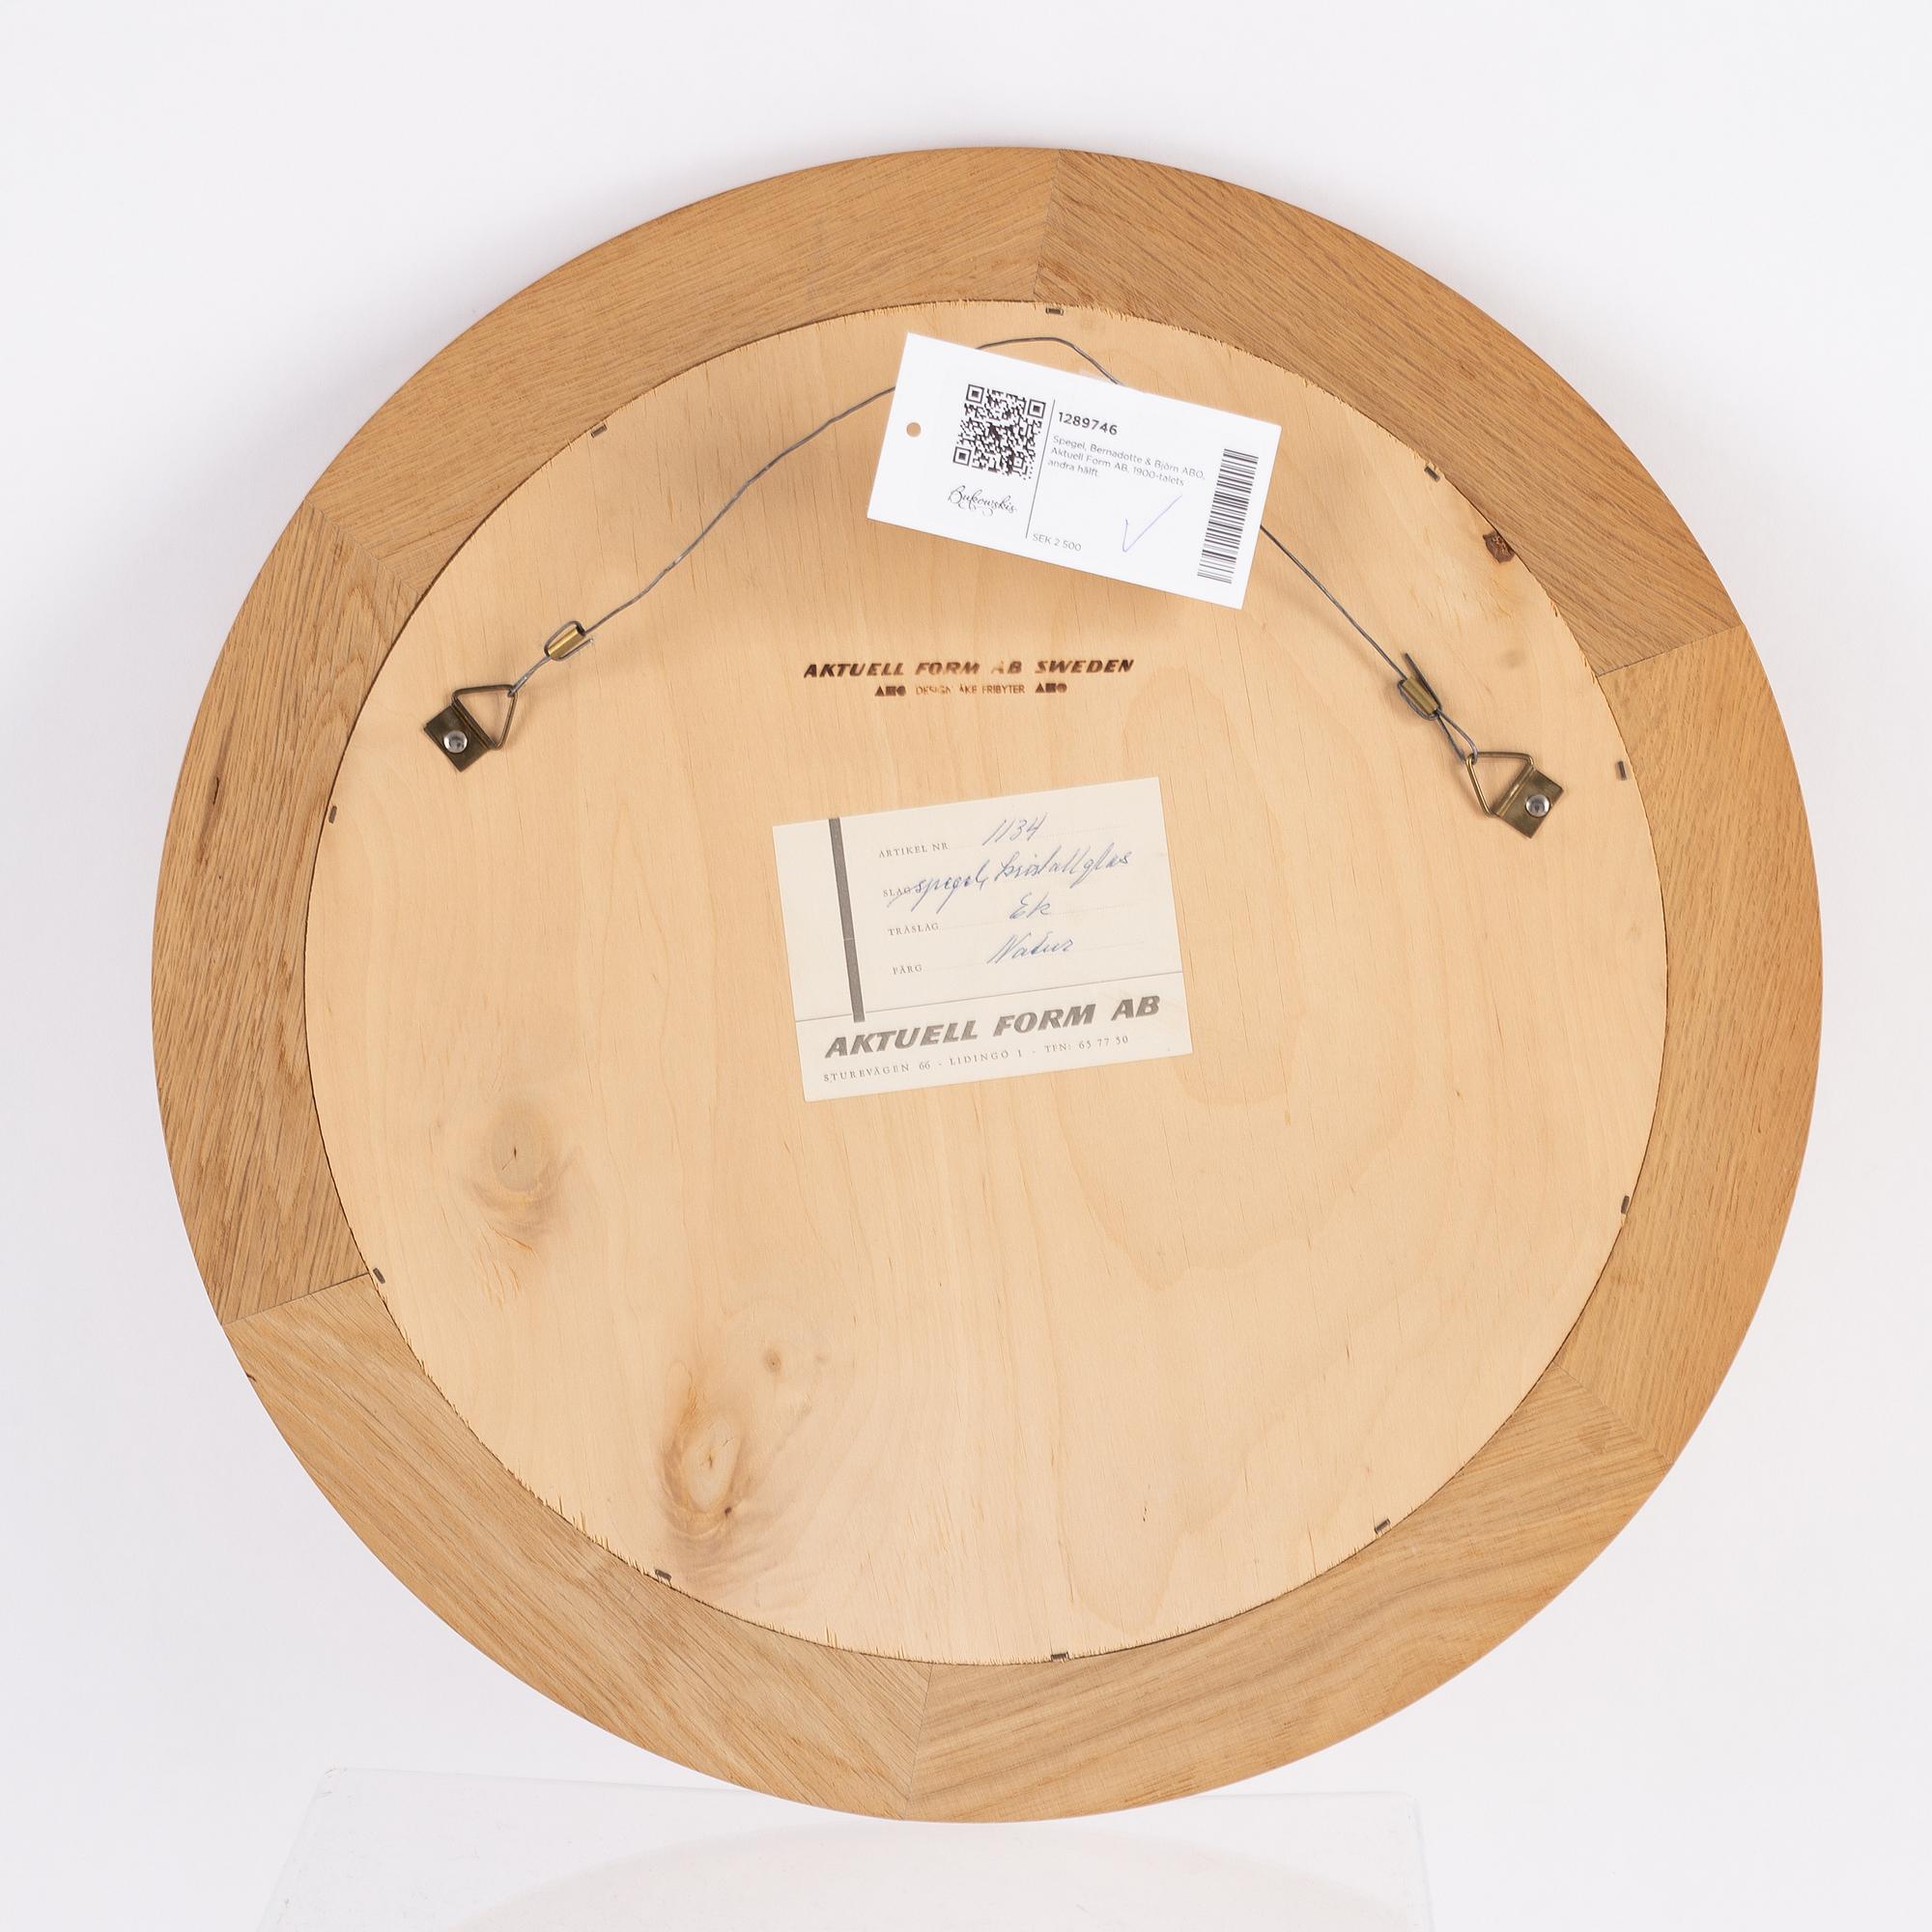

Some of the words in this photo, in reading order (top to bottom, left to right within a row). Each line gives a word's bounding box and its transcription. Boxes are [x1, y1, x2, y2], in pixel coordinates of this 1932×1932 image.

[1059, 412, 1118, 436] 1289746
[1053, 435, 1087, 451] Spegel,
[1090, 443, 1143, 465] Bernadotte
[1145, 457, 1151, 466] &
[1047, 459, 1075, 471] andra
[1051, 447, 1084, 462] Aktuell
[1086, 454, 1111, 468] Form
[1133, 467, 1184, 487] 1900-talets
[1033, 533, 1052, 545] SEK
[803, 663, 905, 678] AKTUELL
[915, 662, 980, 676] FORM
[1035, 659, 1135, 675] SWEDEN
[981, 684, 1025, 695] FRIBYTER
[982, 812, 1048, 845] 1134
[879, 845, 927, 858] ARTIKEL
[932, 842, 950, 851] NR
[824, 1019, 979, 1059] AKTUELL
[993, 1004, 1096, 1037] FORM
[1111, 995, 1160, 1021] AB
[919, 1061, 931, 1070] 66
[1079, 1039, 1092, 1049] 65
[1096, 1037, 1110, 1047] 77
[1115, 1036, 1129, 1045] 50
